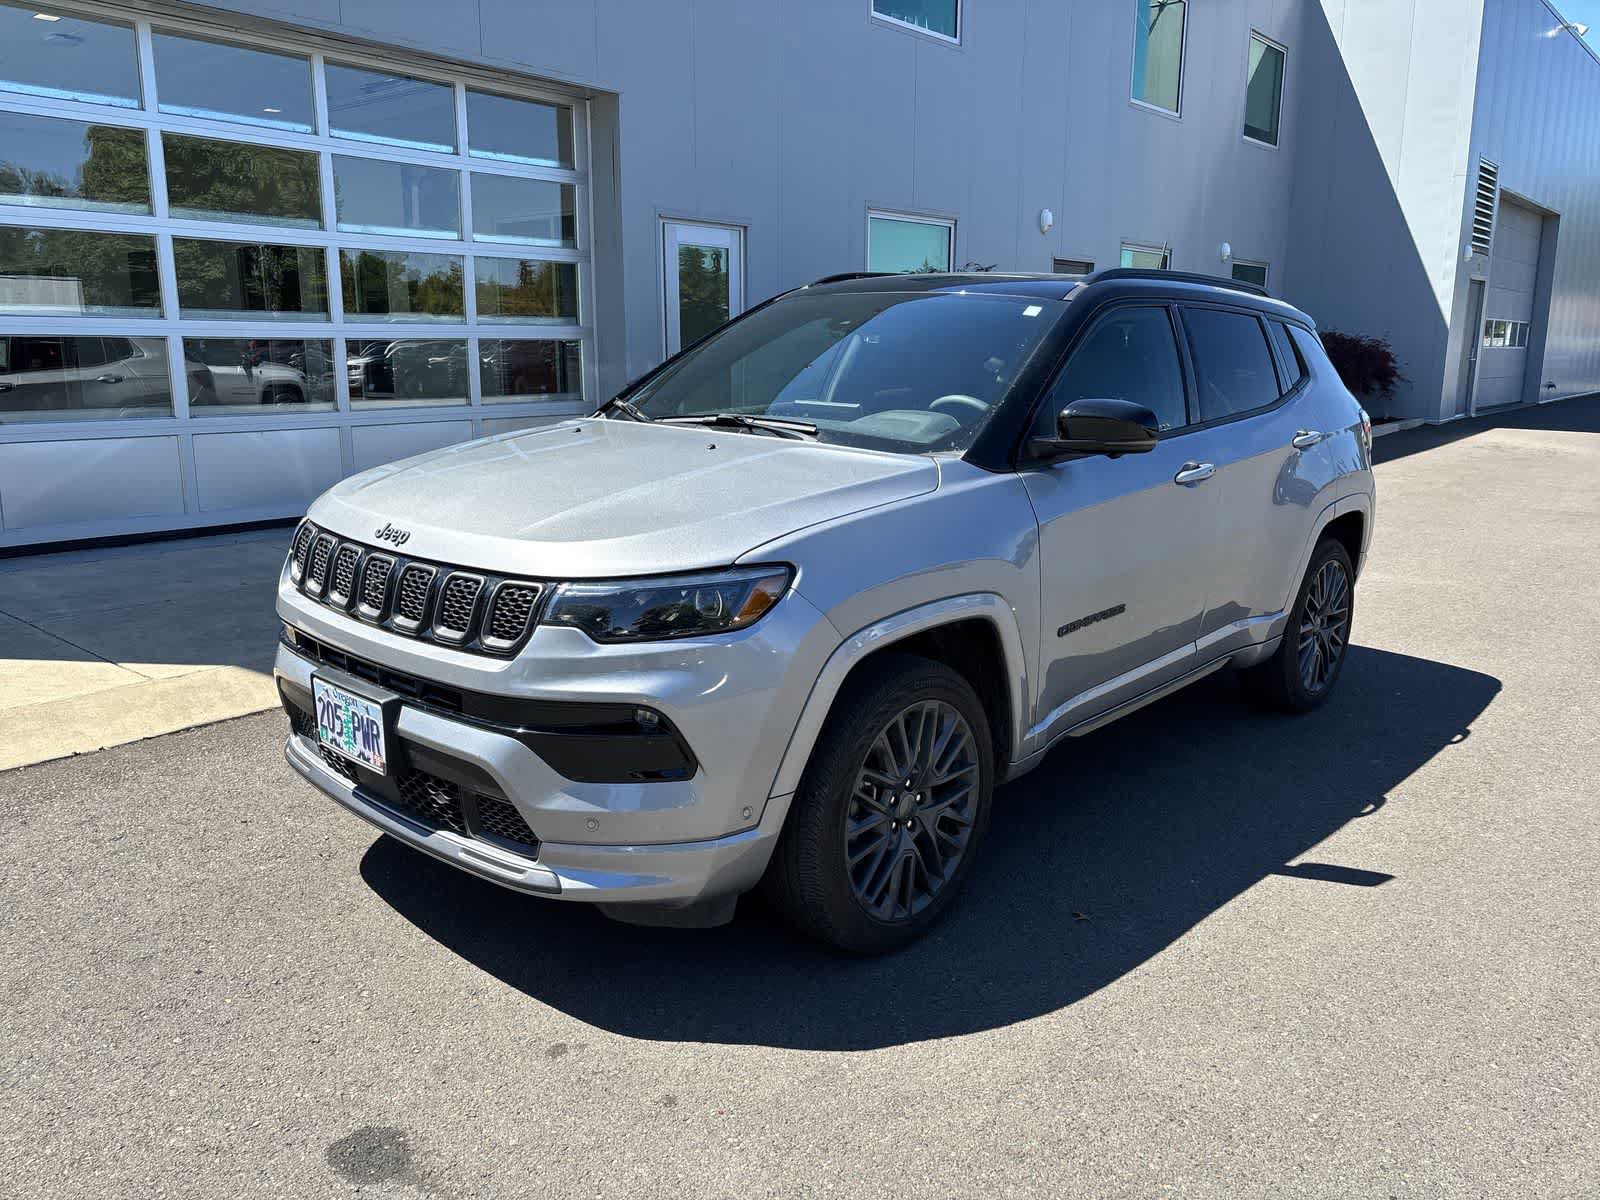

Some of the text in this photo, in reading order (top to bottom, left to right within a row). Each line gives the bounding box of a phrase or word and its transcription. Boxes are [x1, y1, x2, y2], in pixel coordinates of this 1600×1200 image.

[375, 523, 411, 547] Jeep
[333, 687, 358, 708] Oregon
[317, 696, 382, 756] 205 PWR
